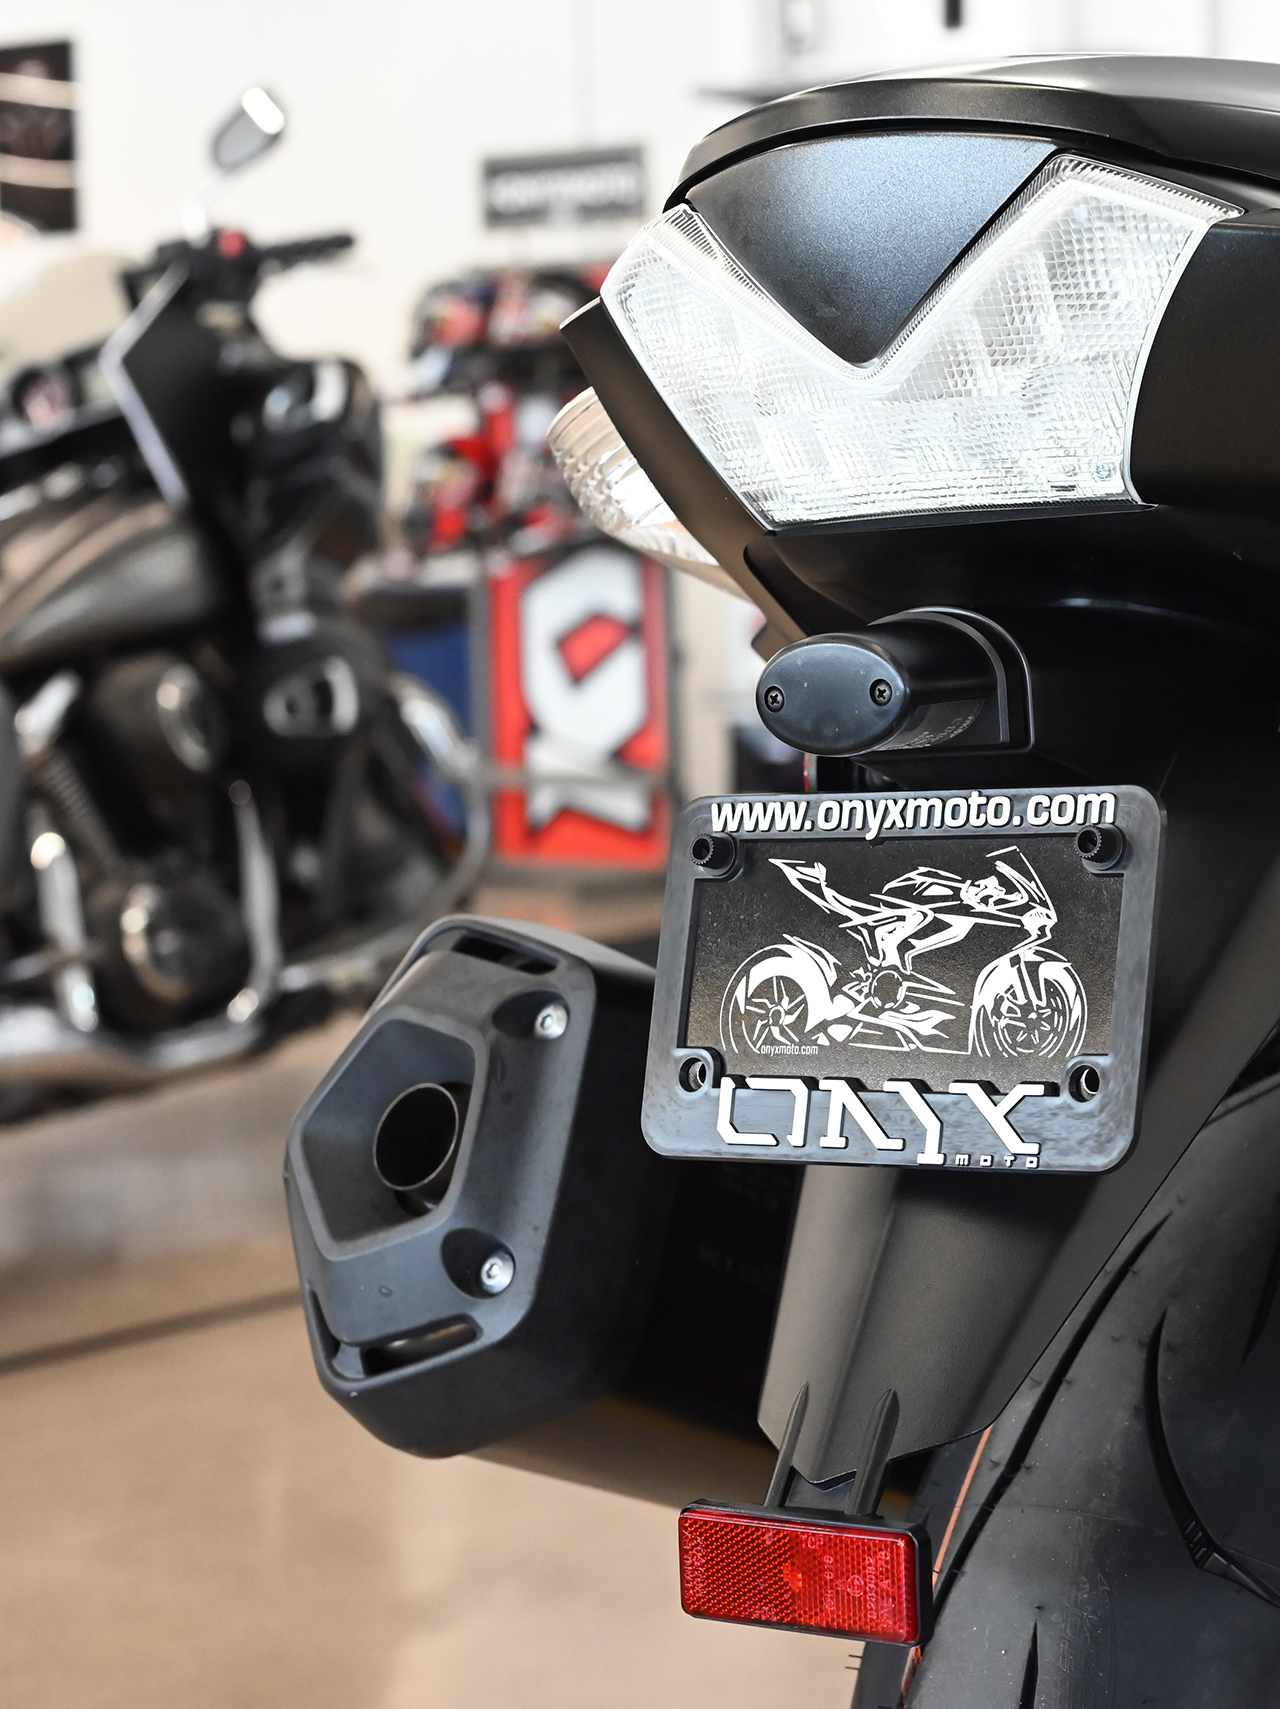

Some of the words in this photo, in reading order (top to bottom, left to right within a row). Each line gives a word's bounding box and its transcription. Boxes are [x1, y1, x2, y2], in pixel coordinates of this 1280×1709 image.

[711, 791, 1116, 841] www.onyxmoto.com
[760, 1043, 819, 1057] onyxmoto.com
[716, 1076, 1046, 1165] ONYX
